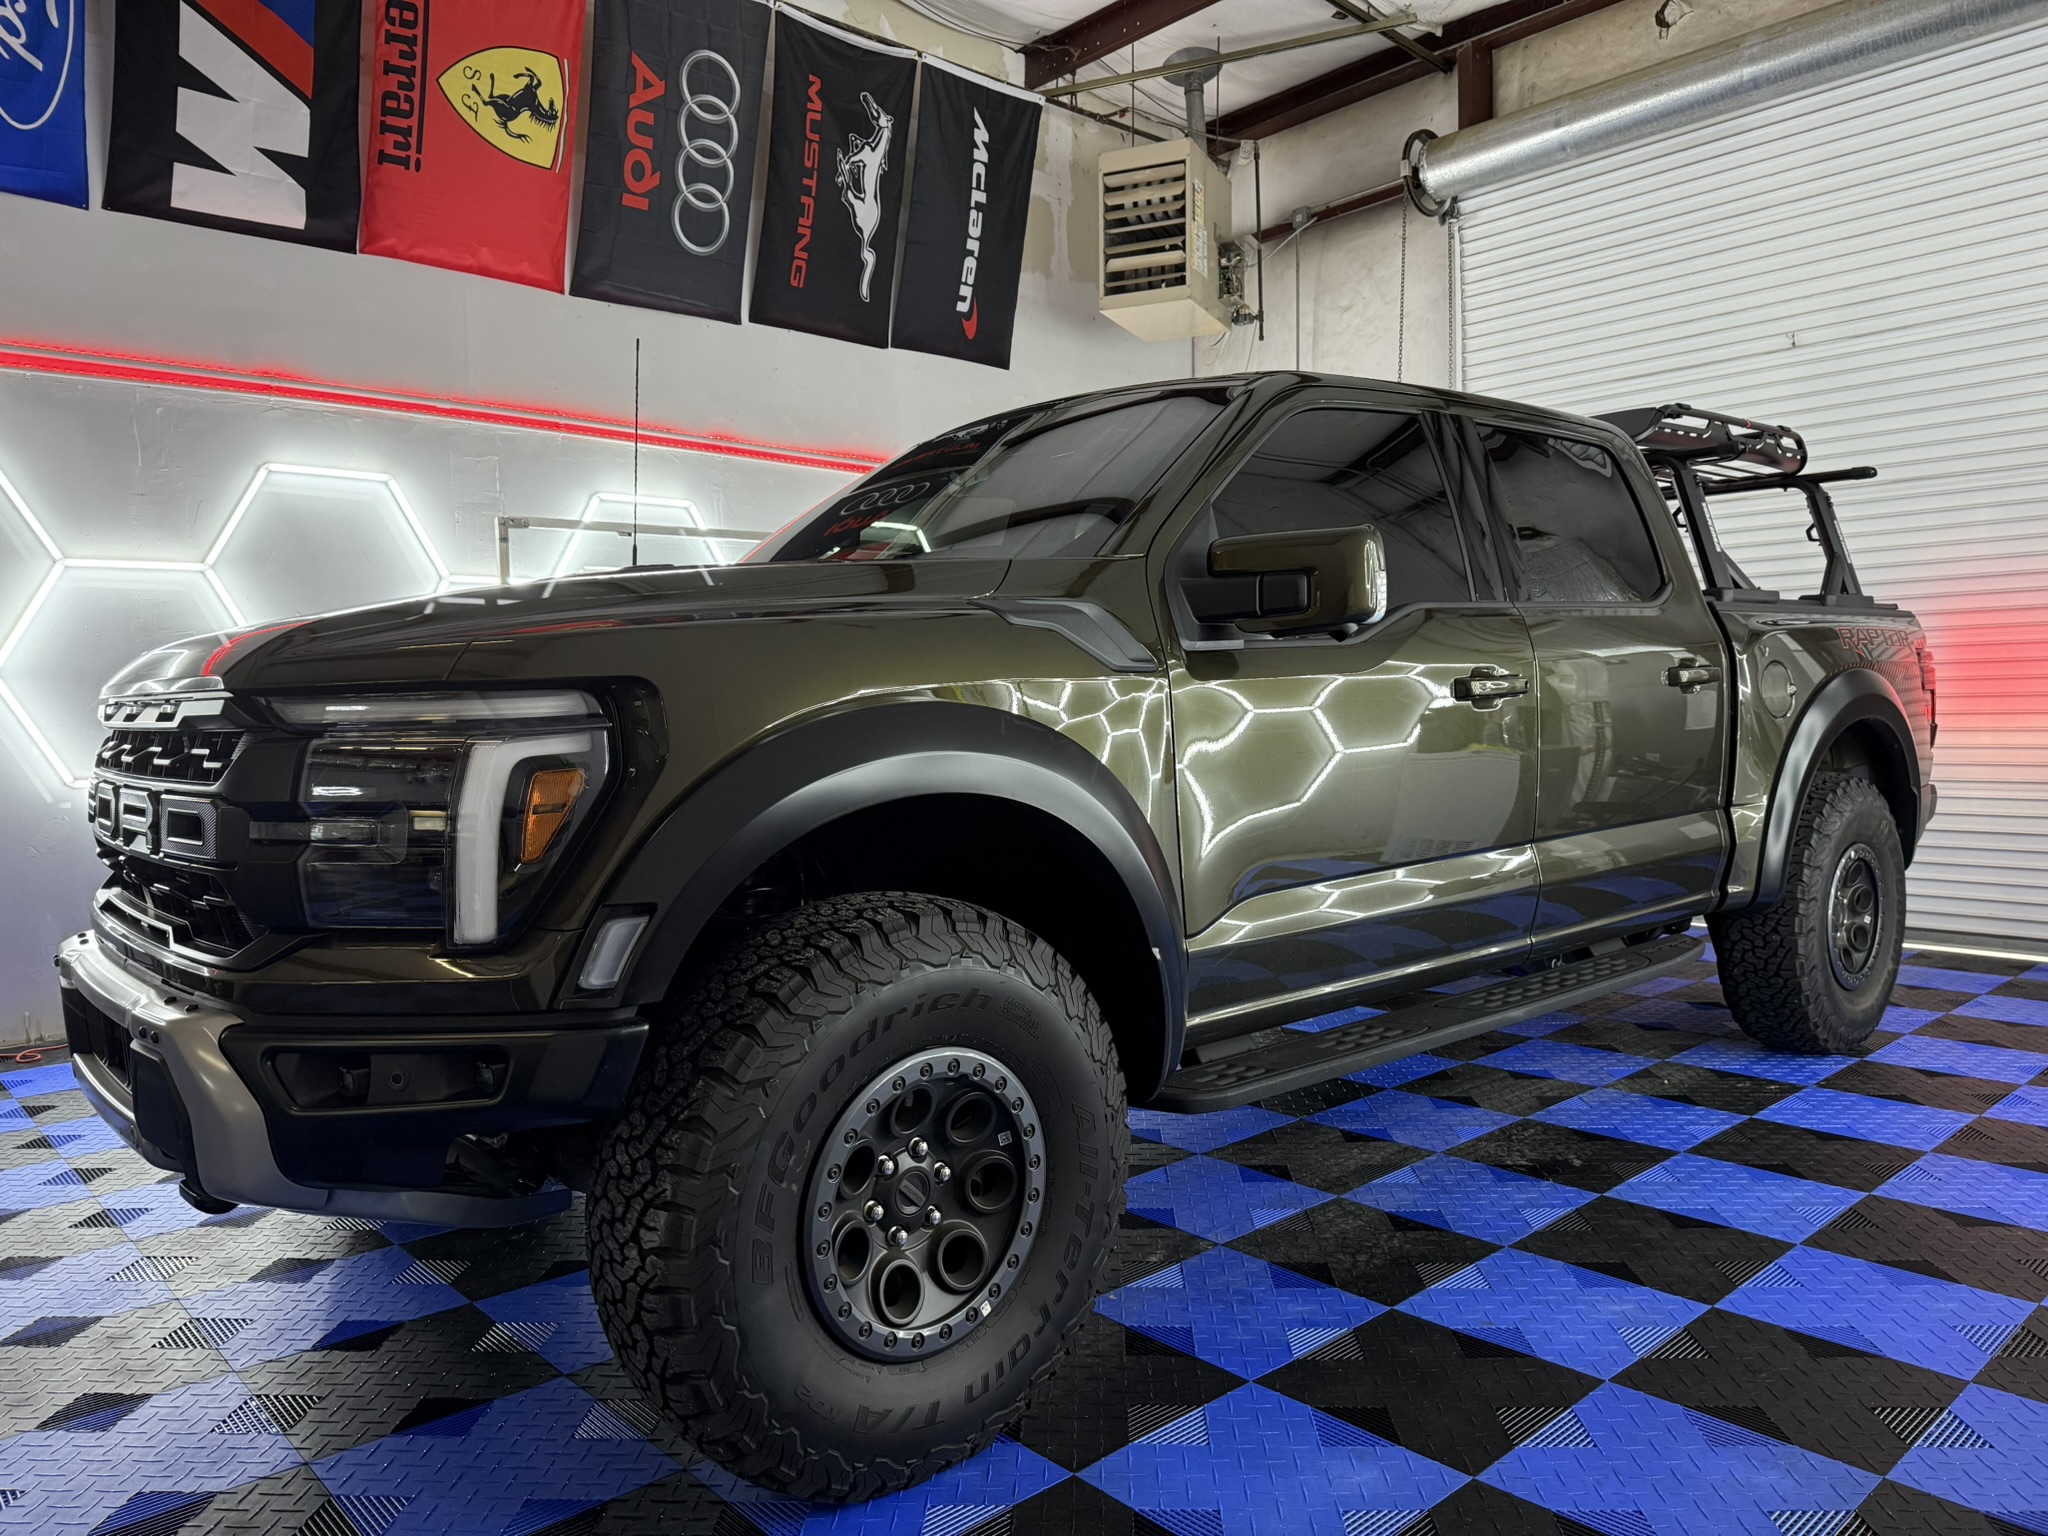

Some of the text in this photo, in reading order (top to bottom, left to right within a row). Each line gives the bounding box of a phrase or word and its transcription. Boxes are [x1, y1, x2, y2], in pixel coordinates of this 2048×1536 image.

[377, 0, 424, 174] errari
[790, 73, 823, 289] MUSTANG
[955, 106, 990, 313] McLaren
[1836, 626, 1914, 658] RAPTOR
[751, 986, 993, 1286] BFGoodrich
[852, 1397, 945, 1435] T/A
